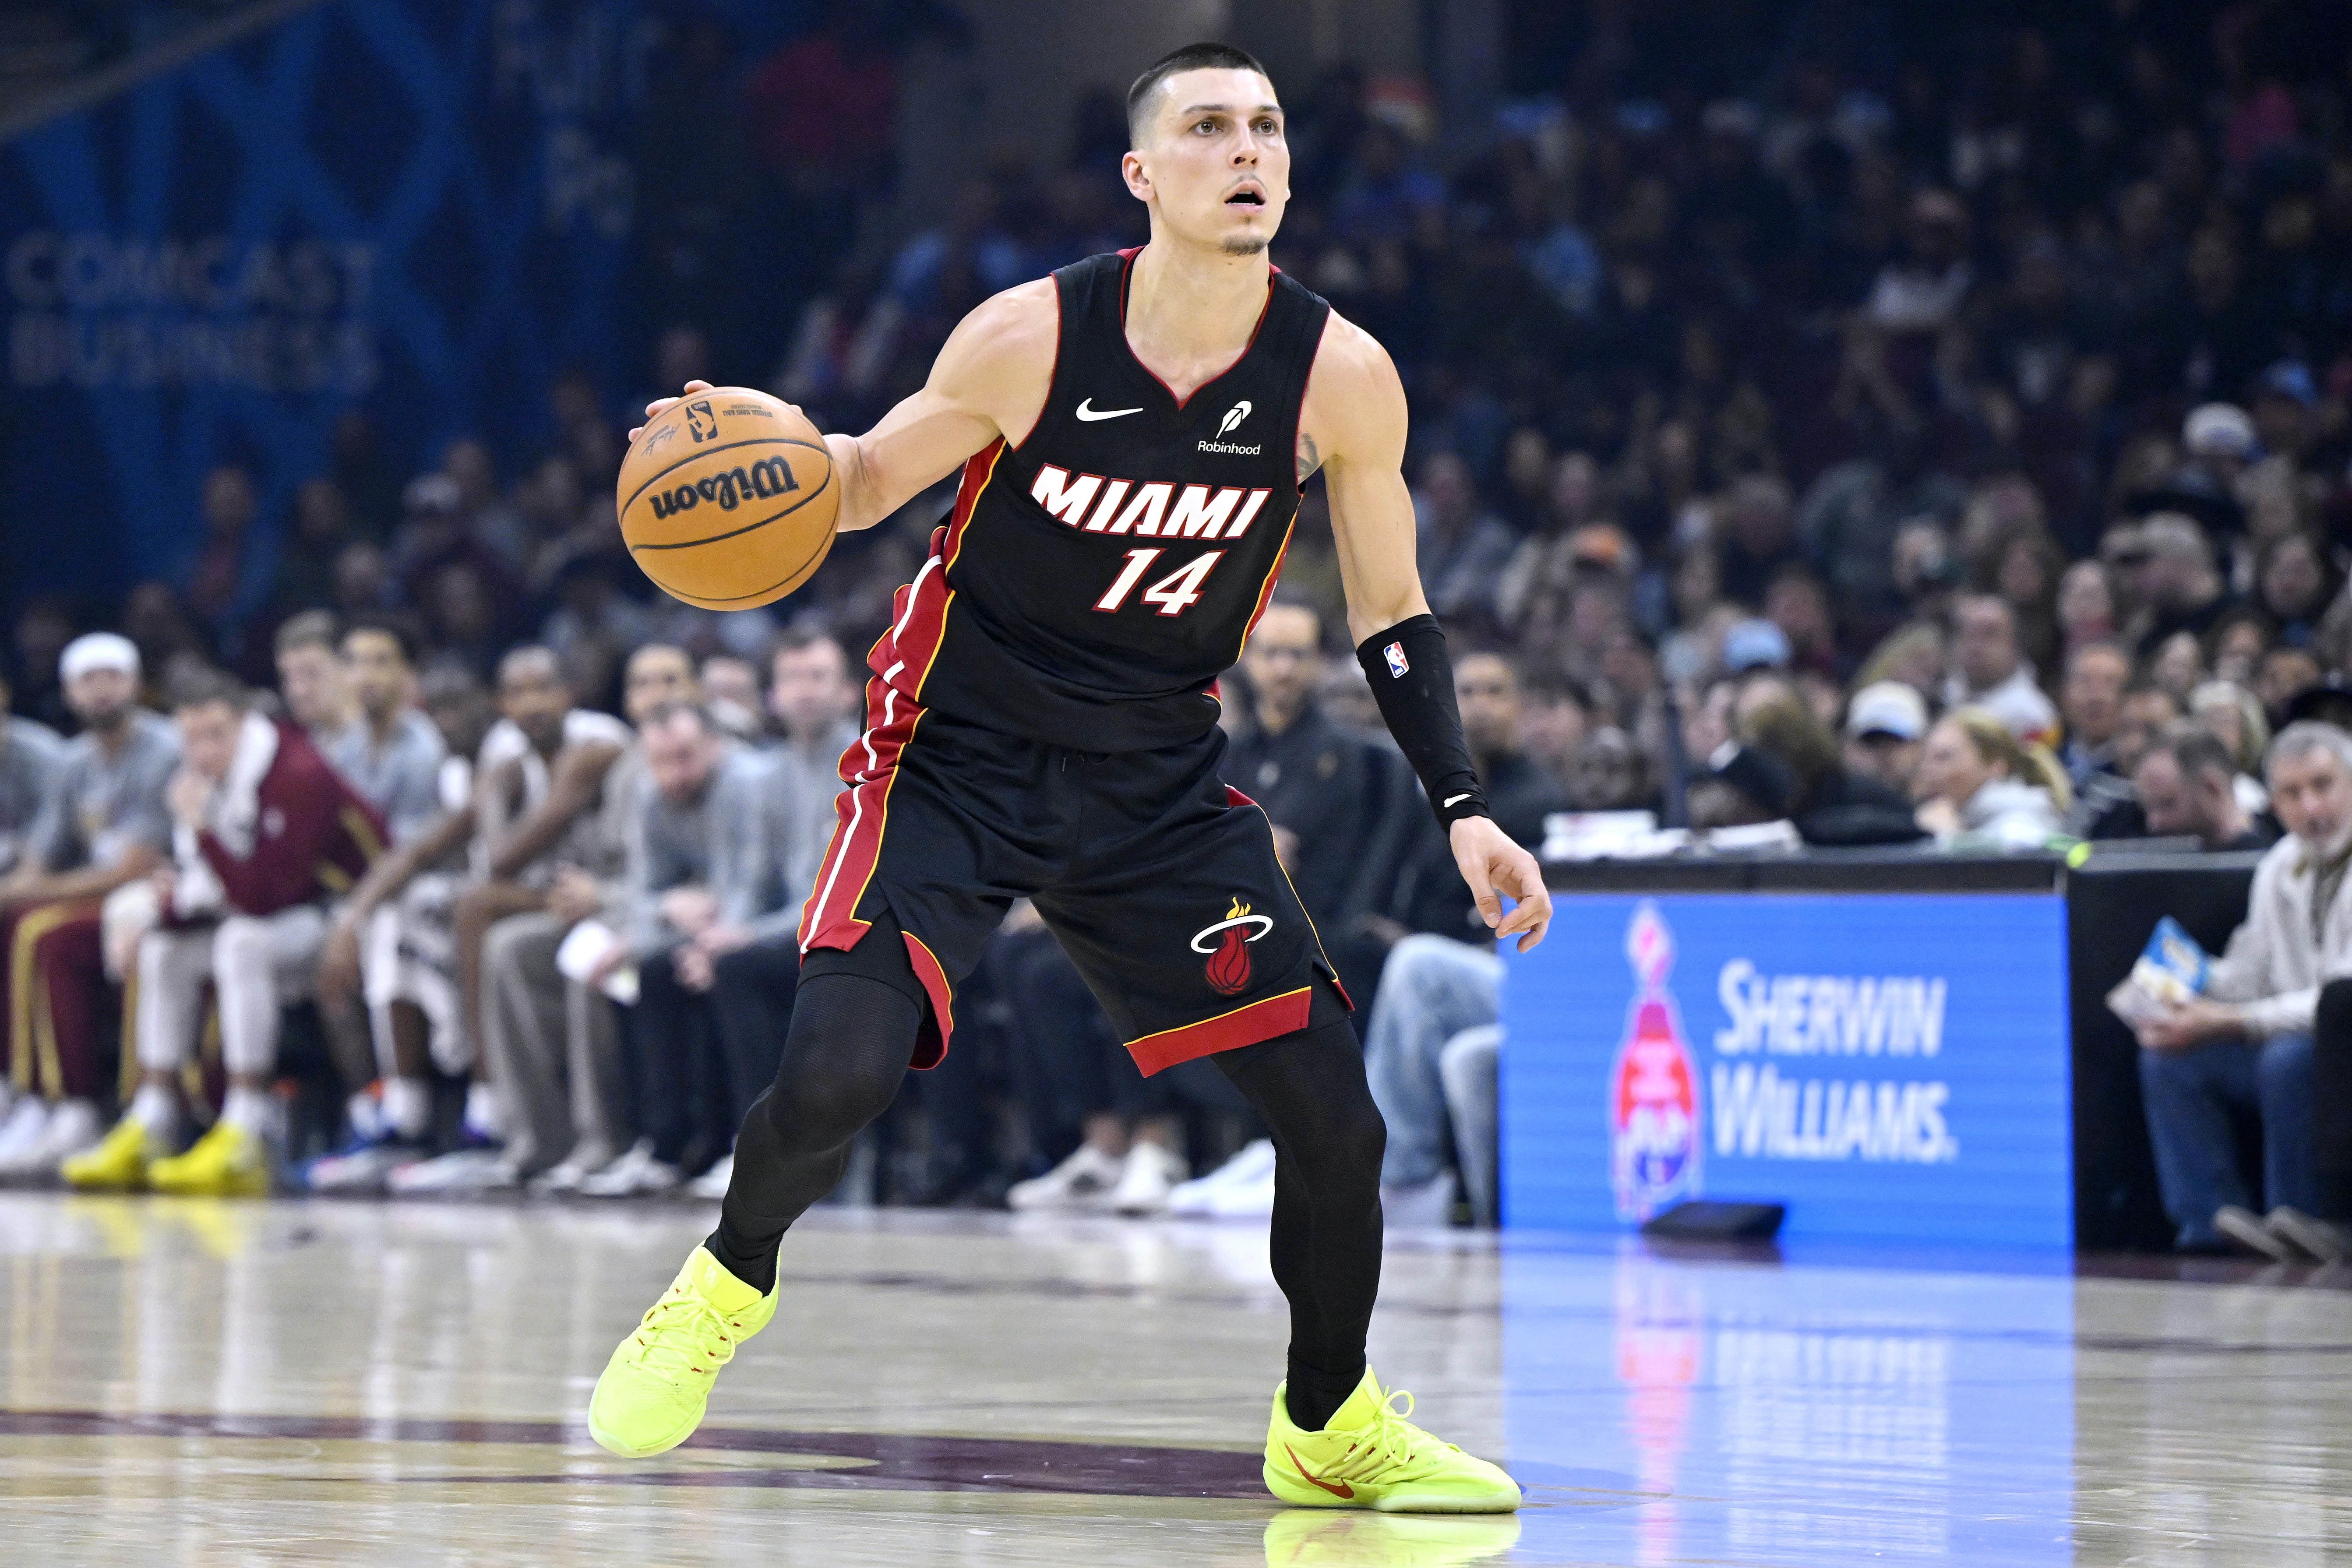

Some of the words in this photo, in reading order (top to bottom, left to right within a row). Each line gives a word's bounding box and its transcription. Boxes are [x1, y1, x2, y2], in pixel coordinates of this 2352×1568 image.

[1198, 441, 1260, 455] Robinhood
[650, 456, 798, 519] Wilson
[1031, 464, 1272, 539] MIAMI
[1092, 548, 1227, 617] 14
[1713, 960, 1947, 1056] SHERWIN
